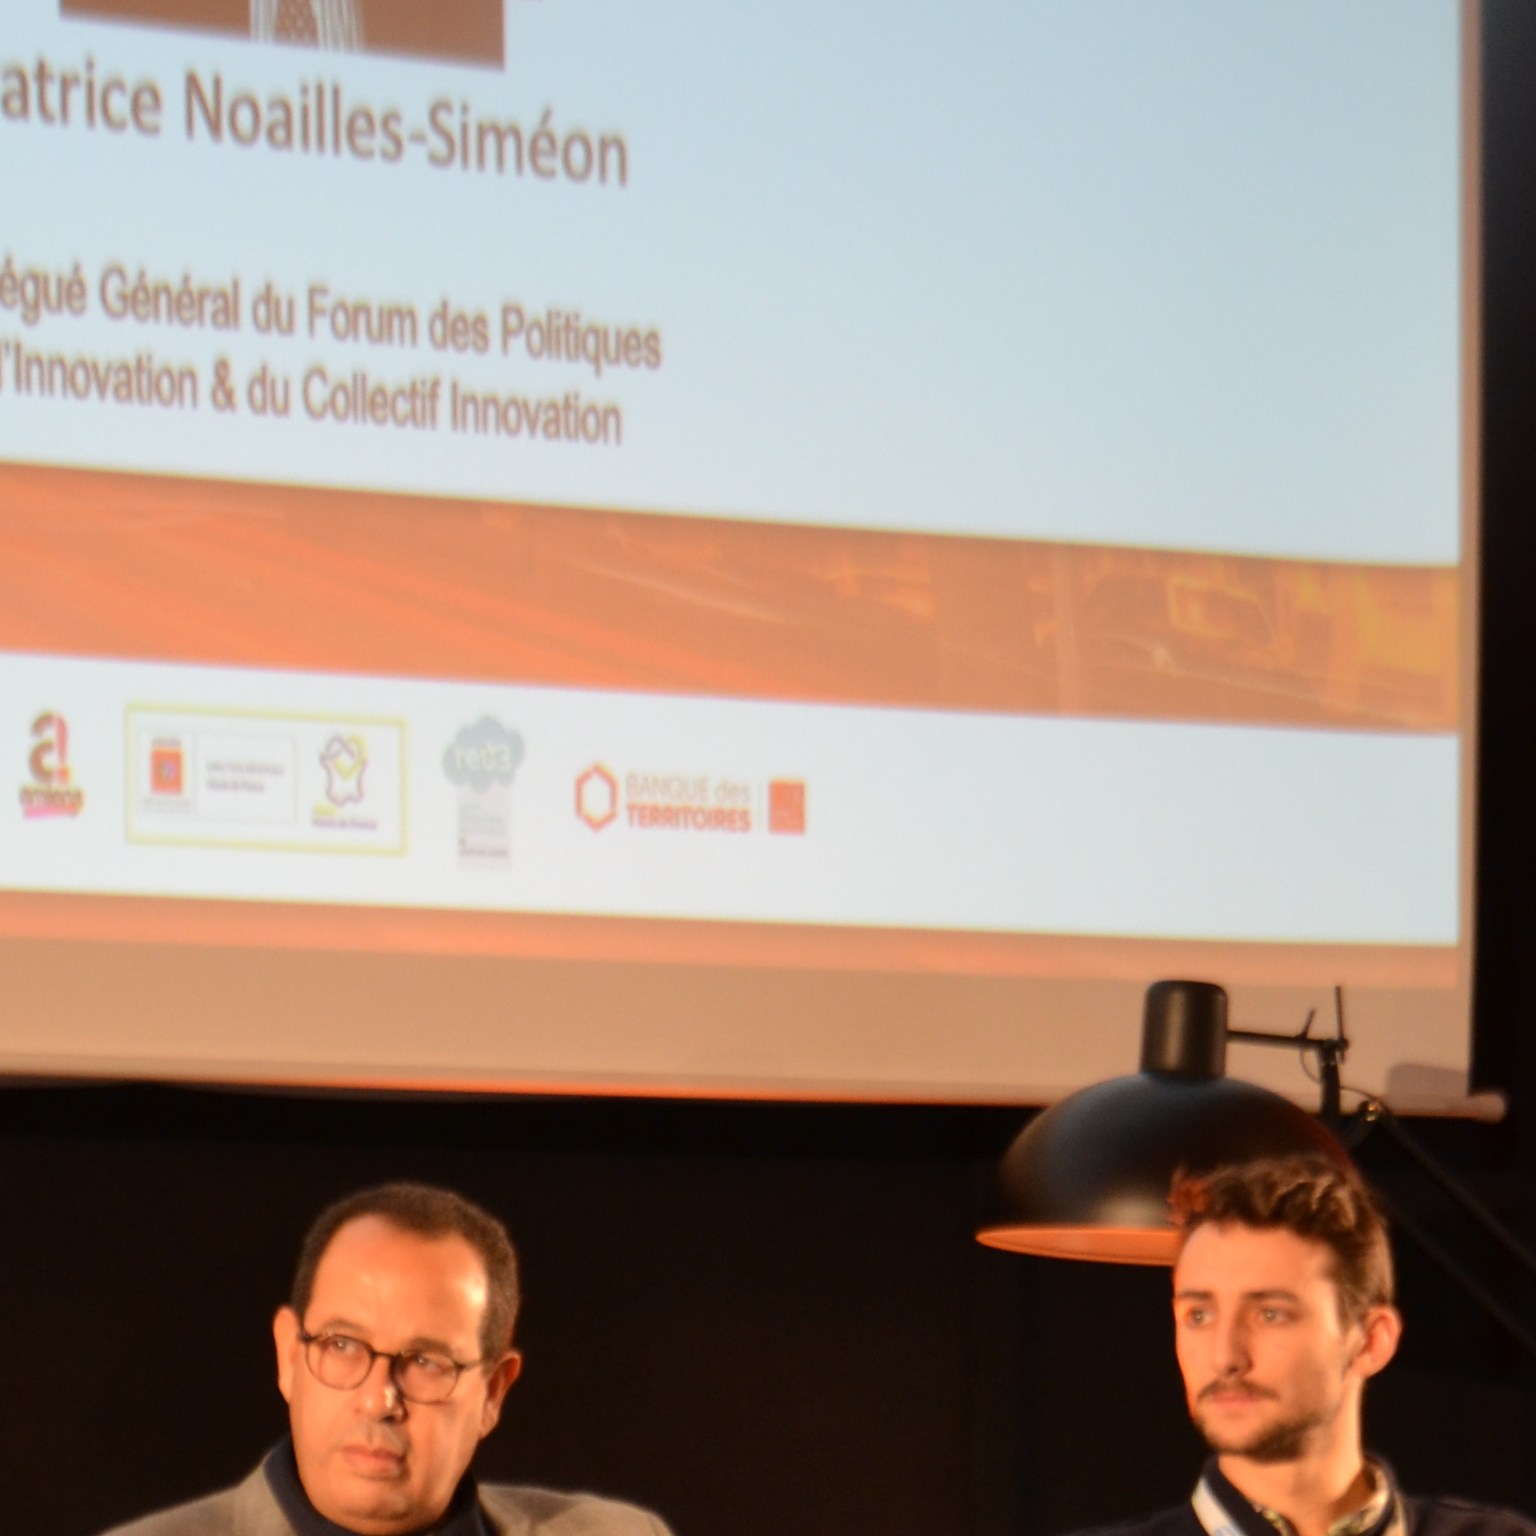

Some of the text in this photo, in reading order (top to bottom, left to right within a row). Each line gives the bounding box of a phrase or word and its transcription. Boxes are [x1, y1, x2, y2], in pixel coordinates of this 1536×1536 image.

[183, 69, 630, 189] Noailles-Siméon
[98, 262, 241, 332] Général
[251, 274, 295, 337] du
[308, 285, 419, 347] Forum
[427, 296, 490, 352] des
[501, 303, 662, 378] Politiques
[211, 355, 236, 413] &
[246, 360, 291, 418] du
[301, 364, 441, 431] Collectif
[451, 379, 623, 445] Innovation
[625, 803, 752, 834] TERRITOIRES
